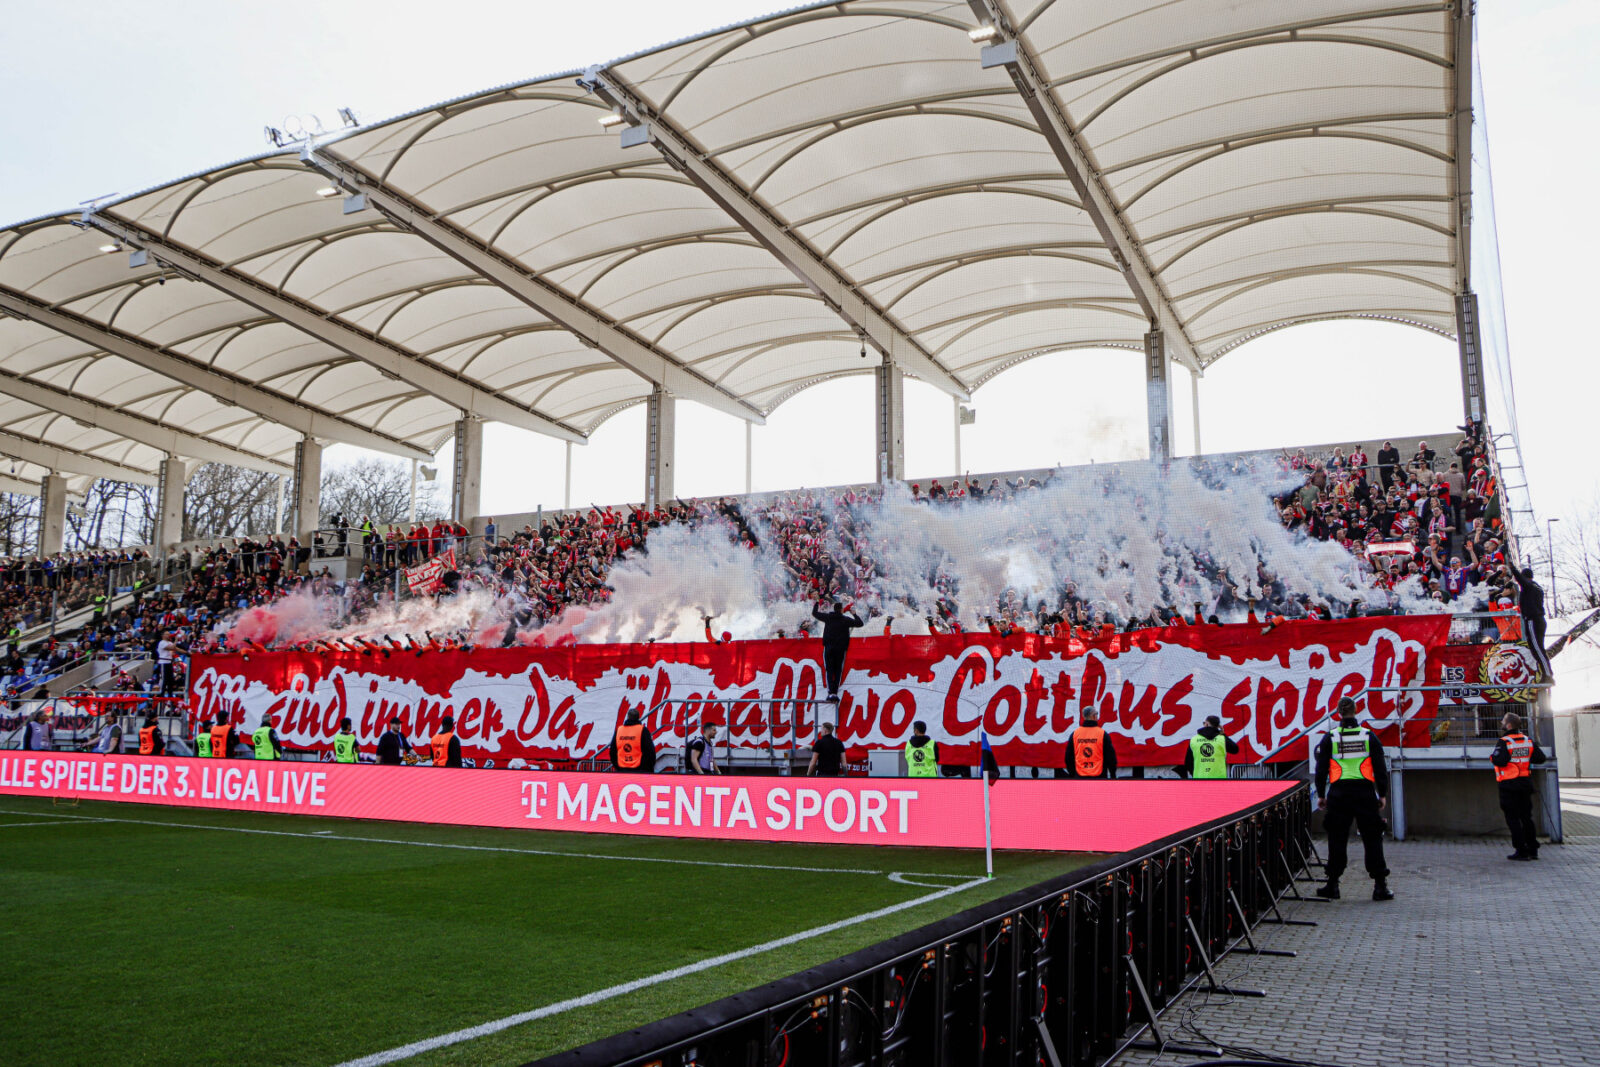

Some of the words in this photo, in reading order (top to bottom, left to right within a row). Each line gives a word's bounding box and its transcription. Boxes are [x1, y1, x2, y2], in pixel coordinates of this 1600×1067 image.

[266, 672, 348, 738] sind
[360, 678, 504, 742] immer
[517, 665, 594, 751] Da,
[614, 663, 818, 741] überall
[838, 687, 918, 742] wo
[942, 651, 1194, 737] Cottbus
[1221, 636, 1419, 751] spielt
[39, 759, 115, 792] SPIELE
[120, 763, 169, 796] DER
[173, 766, 195, 798] 3.
[201, 767, 260, 802] LIGA
[266, 770, 327, 806] LIVE
[556, 782, 758, 829] MAGENTA
[766, 787, 918, 834] SPORT
